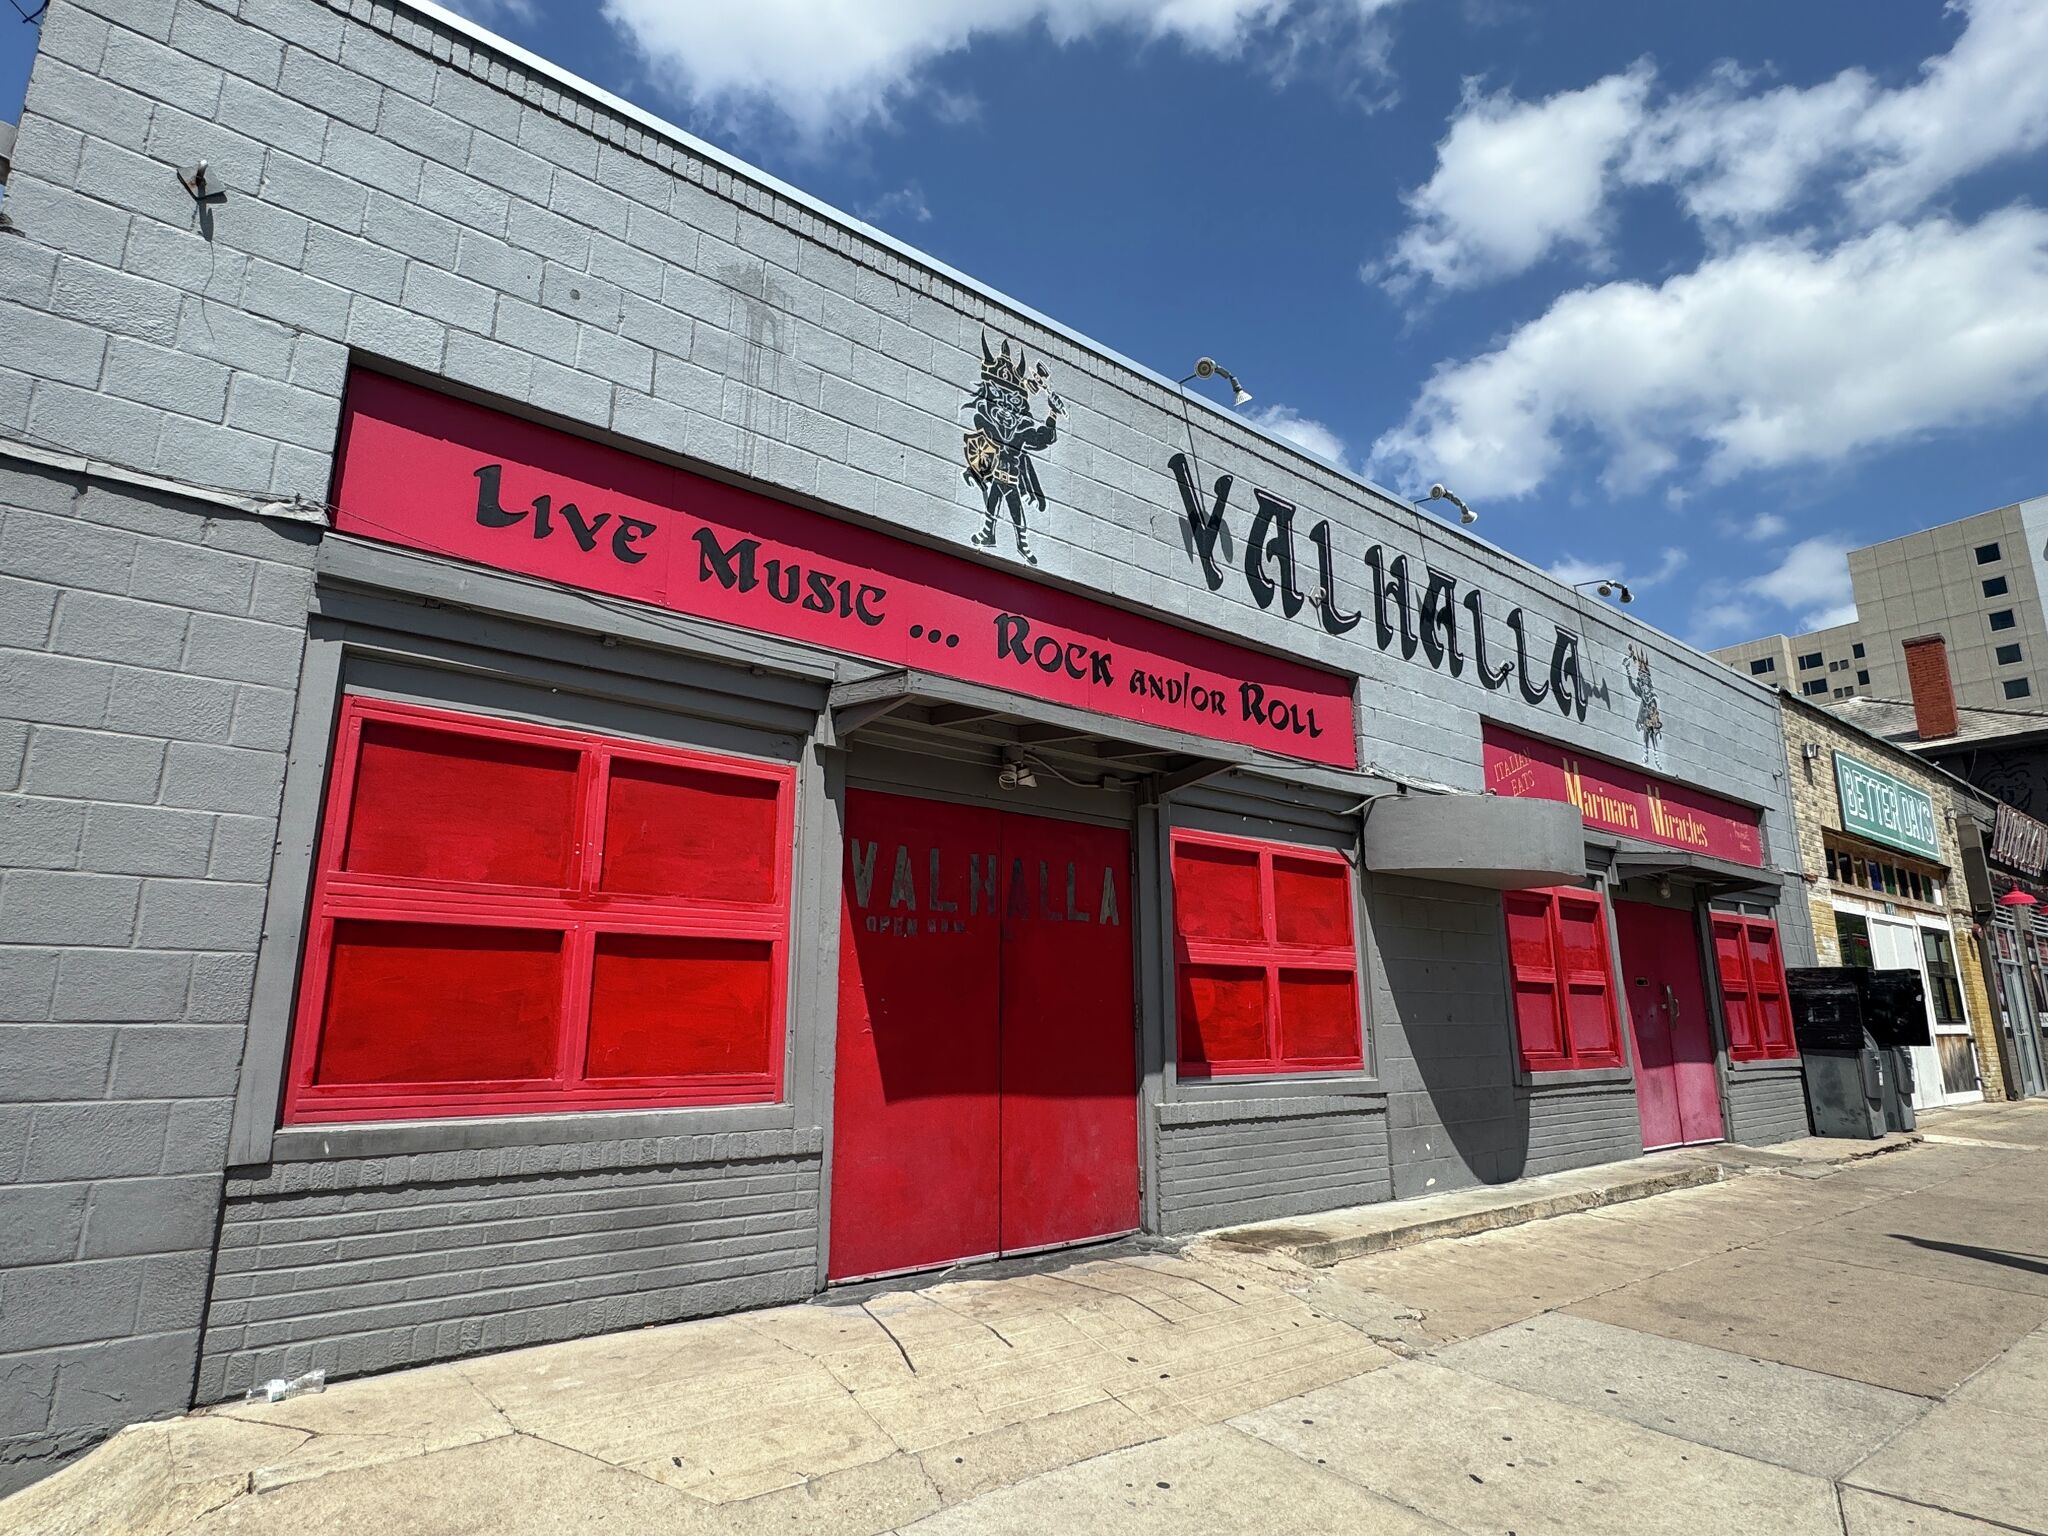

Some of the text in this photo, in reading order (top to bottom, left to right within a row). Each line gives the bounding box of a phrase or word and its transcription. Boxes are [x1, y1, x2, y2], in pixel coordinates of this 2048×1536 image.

[473, 464, 657, 564] LIVE
[691, 527, 887, 626] MUSIC
[993, 613, 1114, 688] ROCK
[1239, 682, 1323, 738] ROLL
[1168, 453, 1587, 722] VALHALLA
[1511, 770, 1535, 797] EATS
[1562, 757, 1639, 830] Marinara
[1646, 784, 1708, 847] Miracles
[1842, 765, 1902, 833] BETTER
[1899, 791, 1935, 845] DAYS
[850, 838, 1120, 926] VALHALLA
